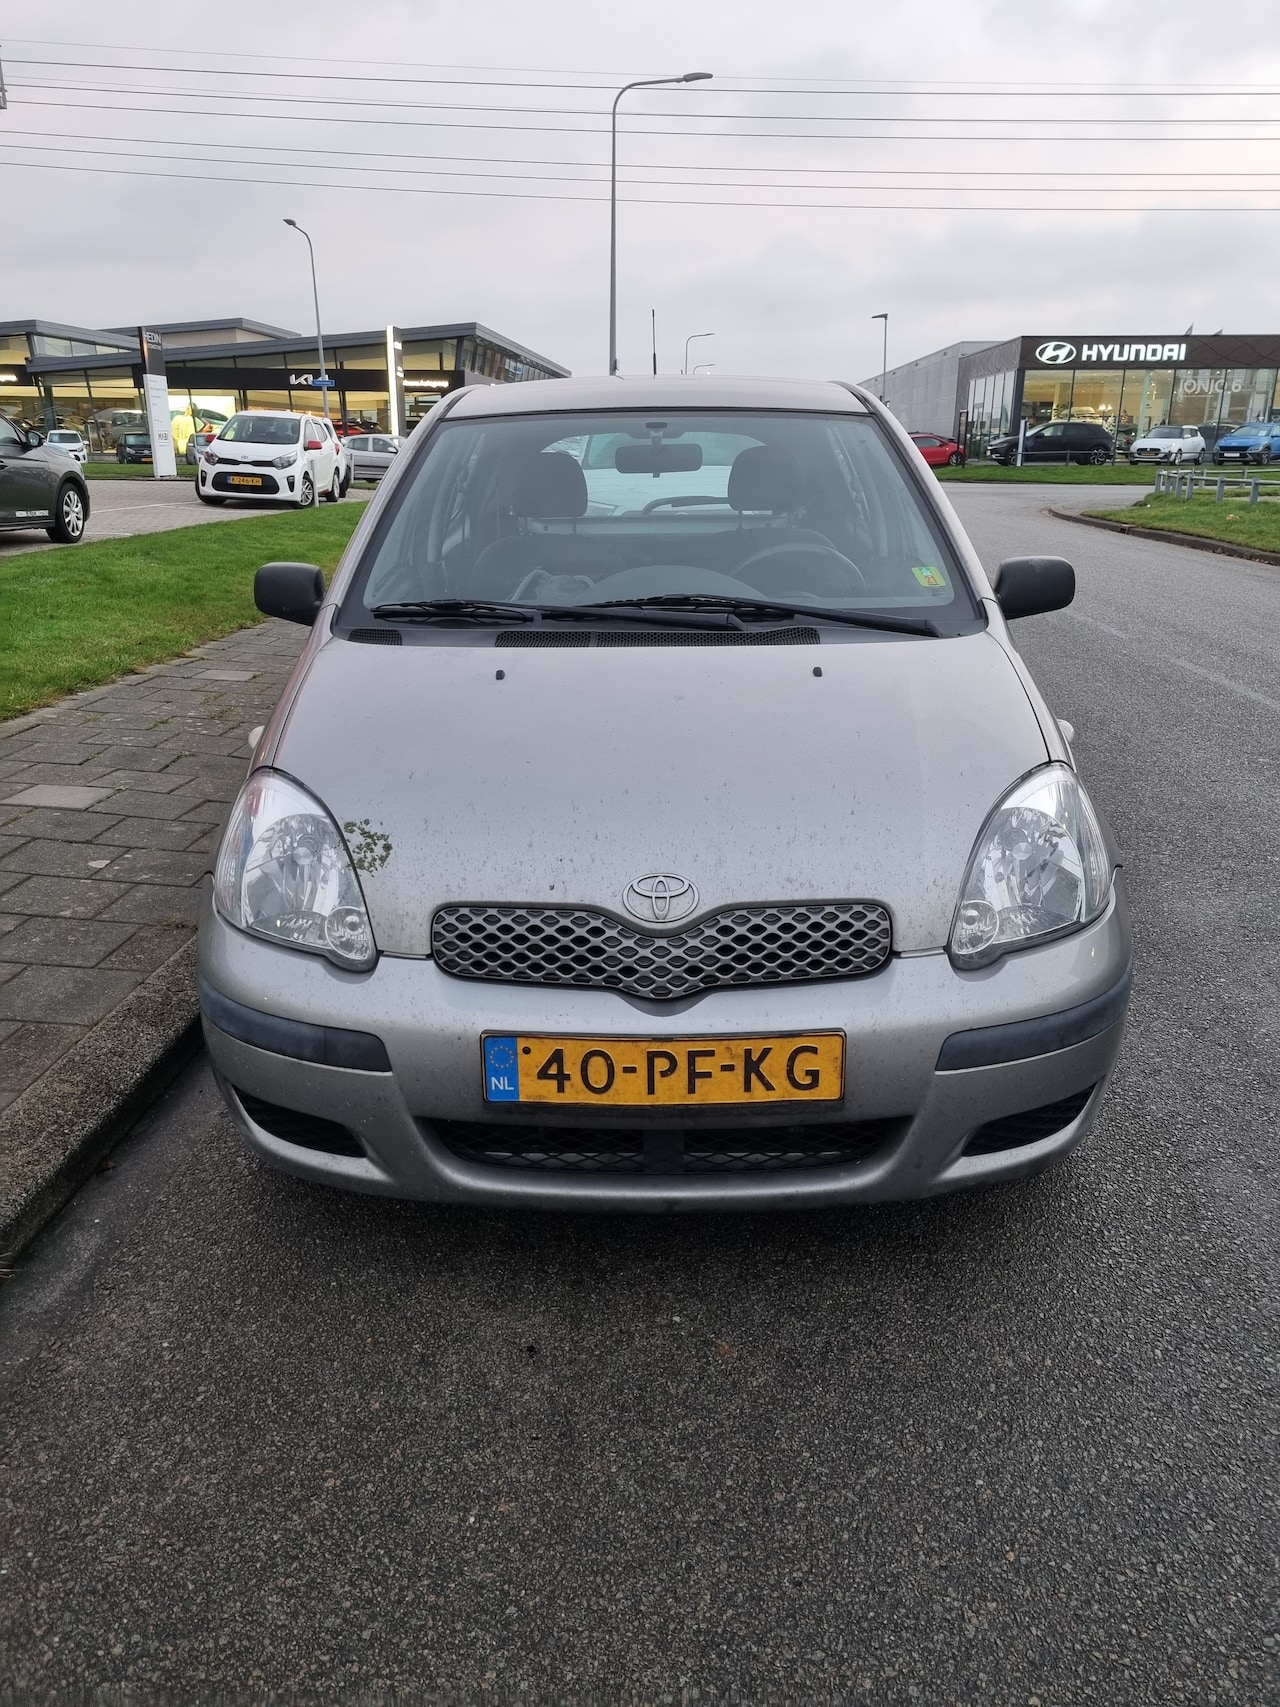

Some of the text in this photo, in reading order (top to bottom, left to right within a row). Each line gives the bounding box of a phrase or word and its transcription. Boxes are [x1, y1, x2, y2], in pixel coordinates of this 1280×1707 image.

[1081, 343, 1187, 362] HYUNDAI
[1231, 380, 1242, 393] 6
[536, 1045, 820, 1095] 40-PF-KG
[491, 1076, 514, 1091] NL
